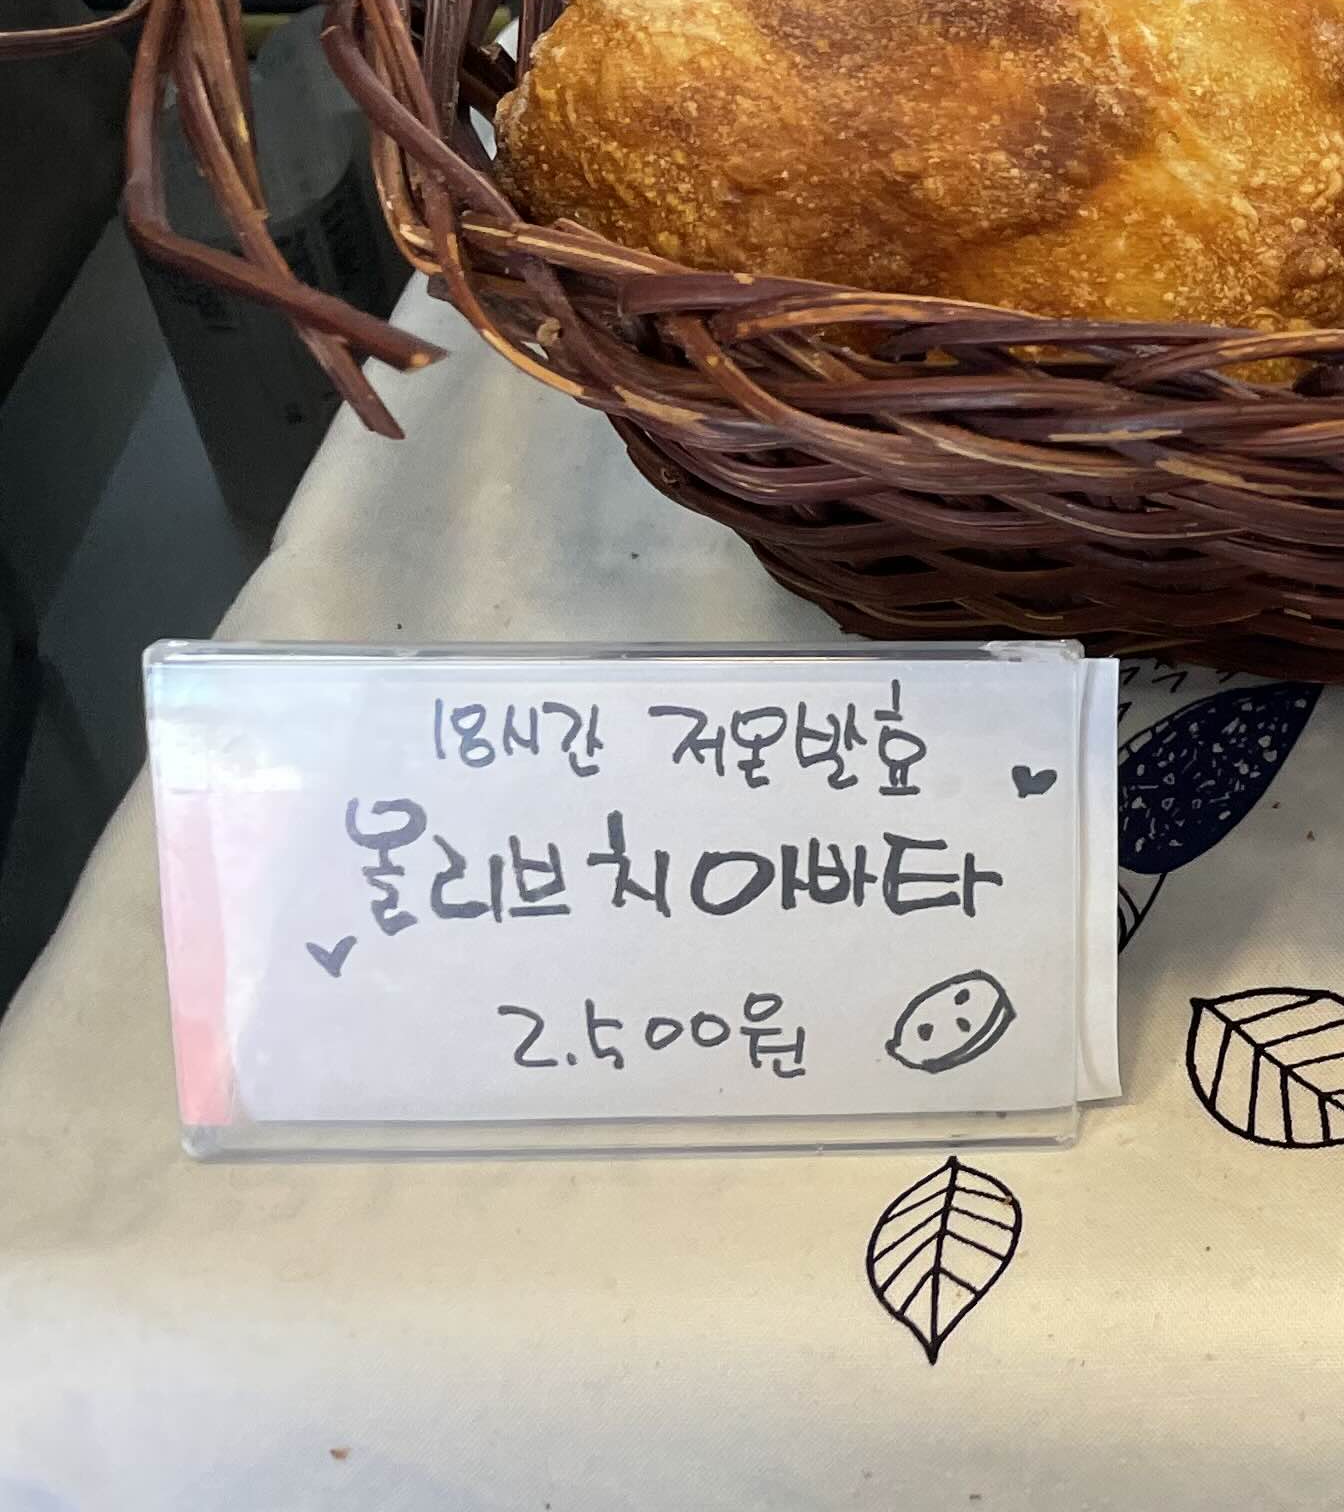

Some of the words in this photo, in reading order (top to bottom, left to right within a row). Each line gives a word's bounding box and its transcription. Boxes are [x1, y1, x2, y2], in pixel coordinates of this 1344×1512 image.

[433, 697, 605, 779] 18시간
[646, 677, 929, 798] 저온발효
[496, 990, 808, 1080] 2.500원
